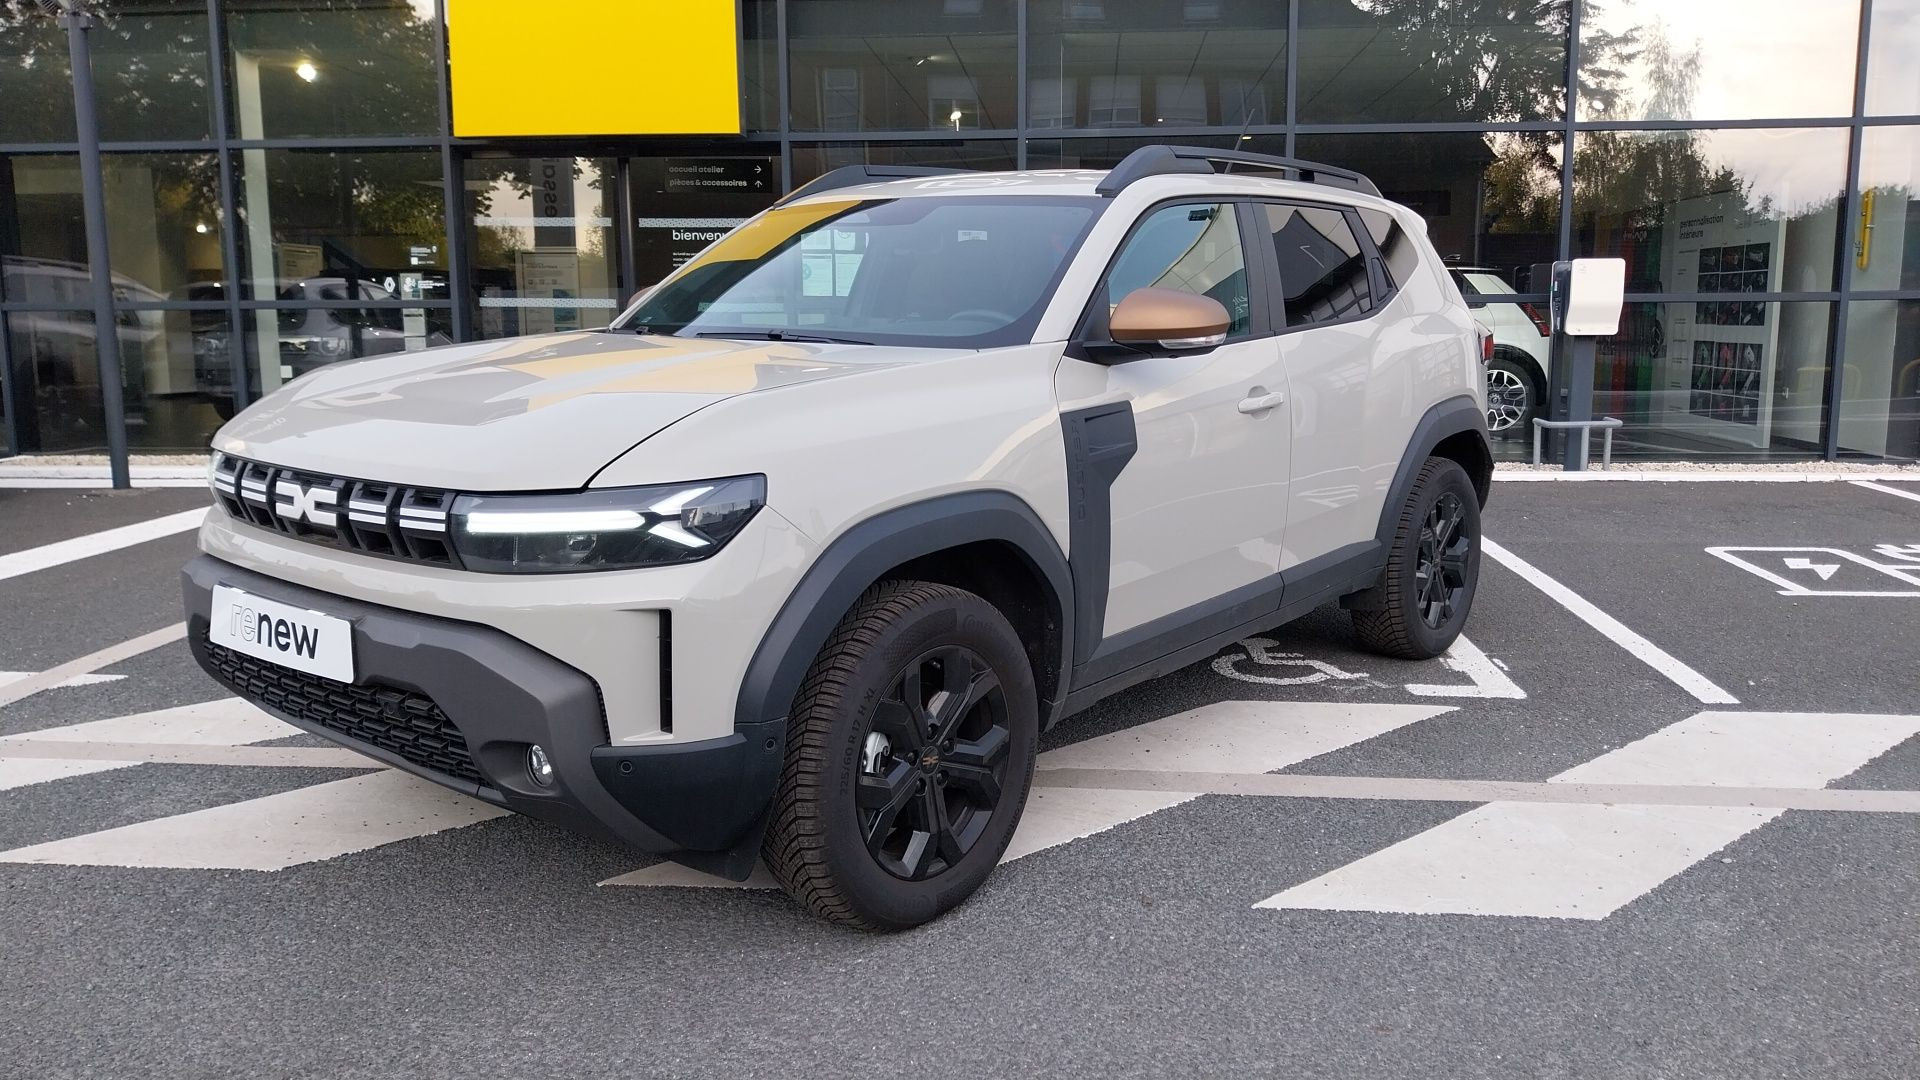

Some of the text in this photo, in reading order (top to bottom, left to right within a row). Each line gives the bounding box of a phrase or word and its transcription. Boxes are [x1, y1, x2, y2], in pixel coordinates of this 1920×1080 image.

[668, 165, 725, 173] accueil atelier
[669, 178, 694, 187] pièces
[702, 178, 748, 187] accessoires
[672, 229, 725, 241] bienven
[230, 603, 319, 660] renew
